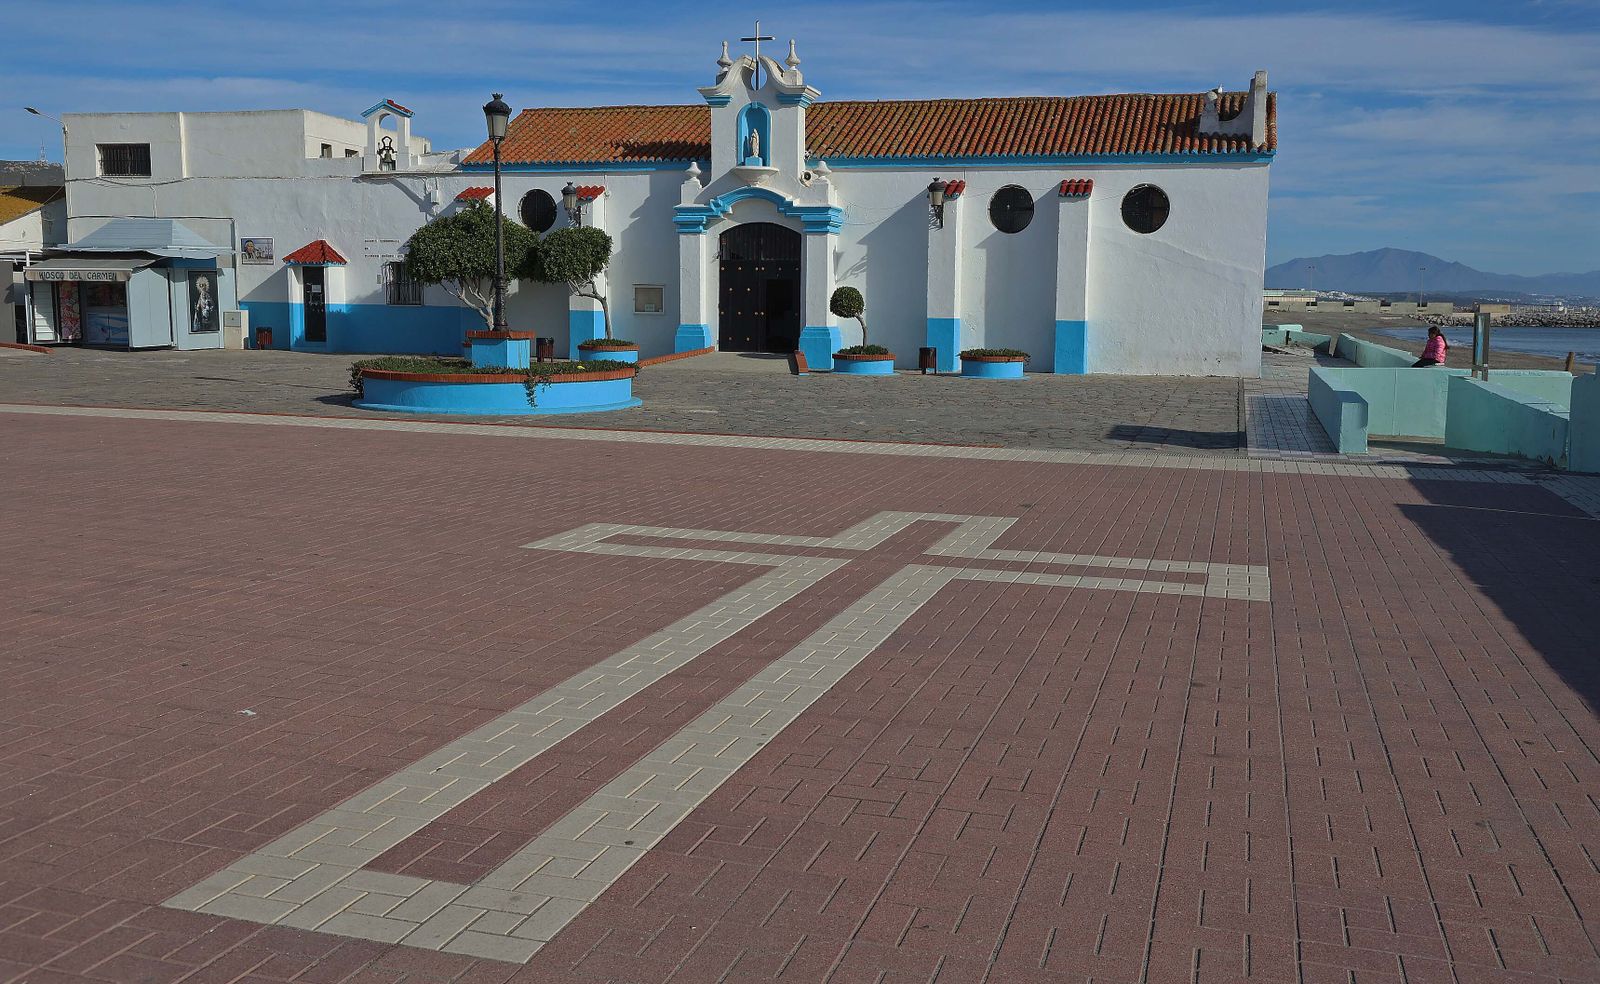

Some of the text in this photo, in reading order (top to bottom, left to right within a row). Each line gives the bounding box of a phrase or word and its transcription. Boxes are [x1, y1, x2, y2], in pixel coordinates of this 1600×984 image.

[39, 272, 117, 280] KIOSCO DEL CARMEN
